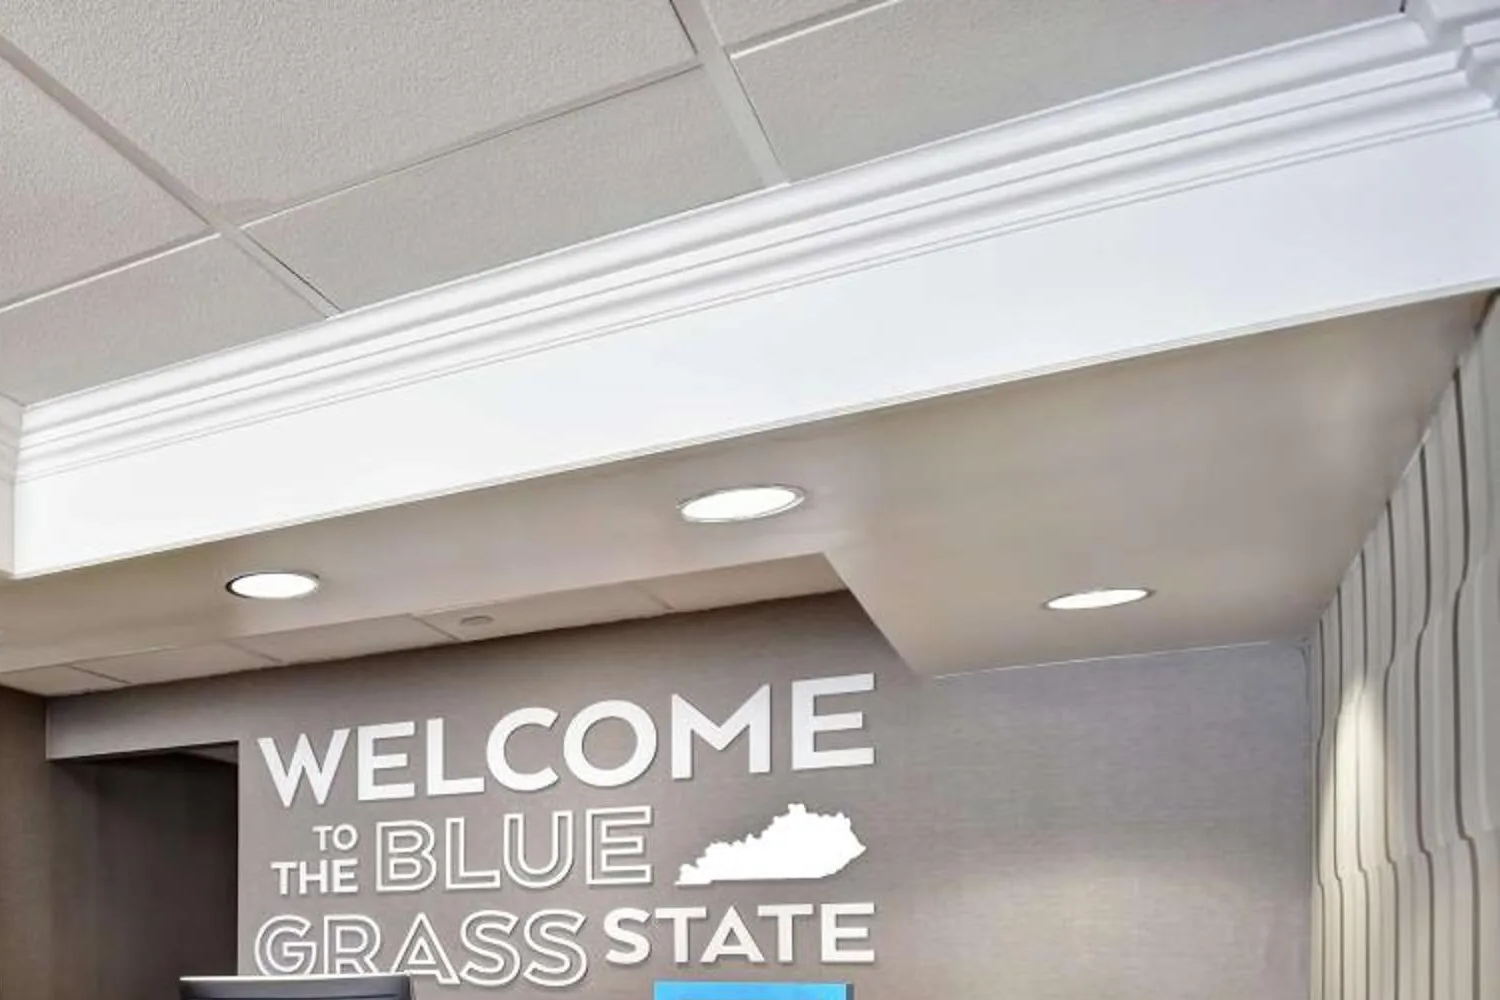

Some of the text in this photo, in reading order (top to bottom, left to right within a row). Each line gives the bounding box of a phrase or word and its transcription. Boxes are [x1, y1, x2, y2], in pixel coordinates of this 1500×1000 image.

[257, 673, 875, 808] WELCOME
[271, 858, 358, 895] THE
[312, 823, 358, 852] TO
[375, 805, 652, 892] BLUE
[254, 902, 875, 986] GRASS STATE
